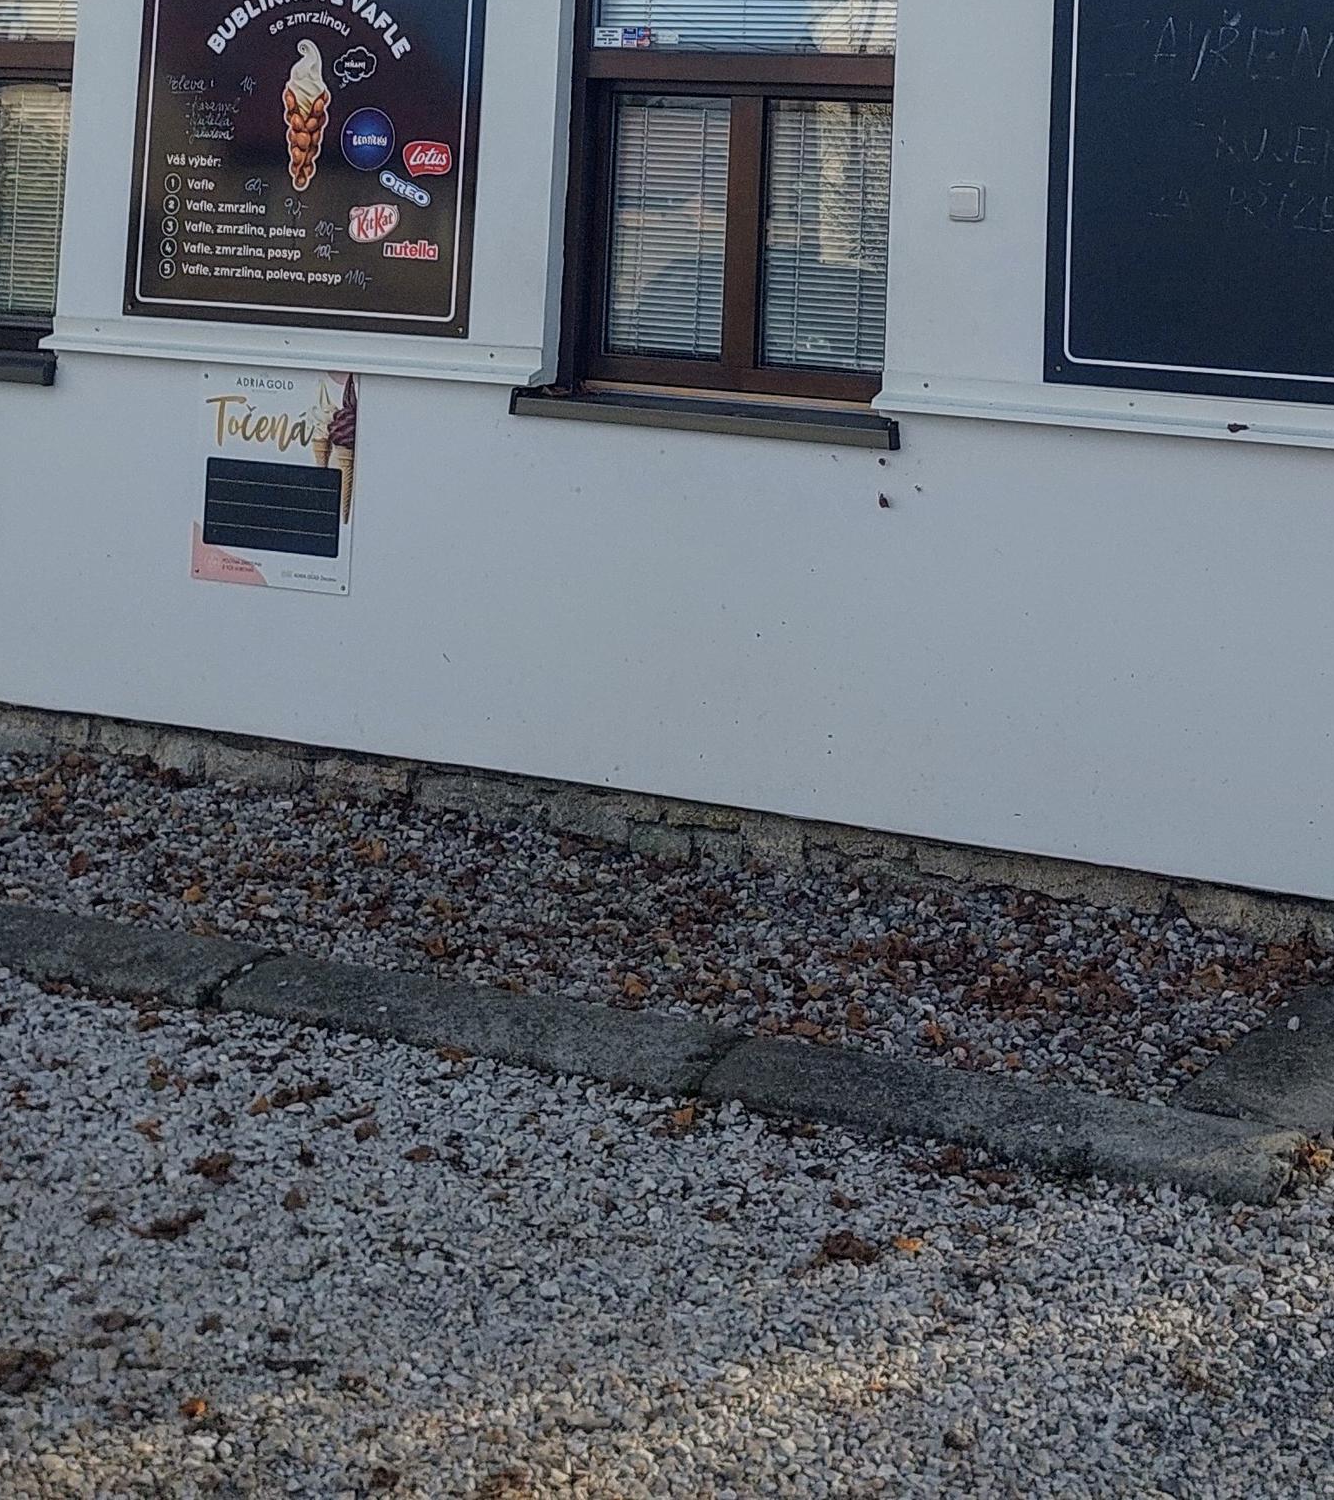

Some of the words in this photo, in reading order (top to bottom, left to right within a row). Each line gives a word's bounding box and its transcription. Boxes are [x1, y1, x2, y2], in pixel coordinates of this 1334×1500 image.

[269, 19, 284, 35] se
[286, 10, 351, 37] zmrzlinou
[167, 154, 186, 166] Váš
[188, 155, 222, 168] výběr:
[409, 146, 448, 166] Lotus
[187, 178, 215, 190] Vafle
[381, 173, 429, 204] OREO
[185, 200, 216, 213] Vafle,
[217, 201, 266, 214] zmrzlina
[185, 220, 214, 233] Vafle,
[216, 222, 267, 237] zmrzlina,
[269, 225, 306, 238] poleva
[356, 207, 394, 239] KitKat
[215, 243, 265, 258] zmrzlina,
[267, 248, 302, 260] posyp
[384, 241, 437, 259] nutella
[182, 263, 212, 276] Vafle,
[214, 265, 264, 279] zmrzlina,
[267, 268, 306, 282] poleva,
[308, 271, 342, 285] posyp
[266, 379, 294, 390] GOLD
[206, 396, 315, 452] Točená
